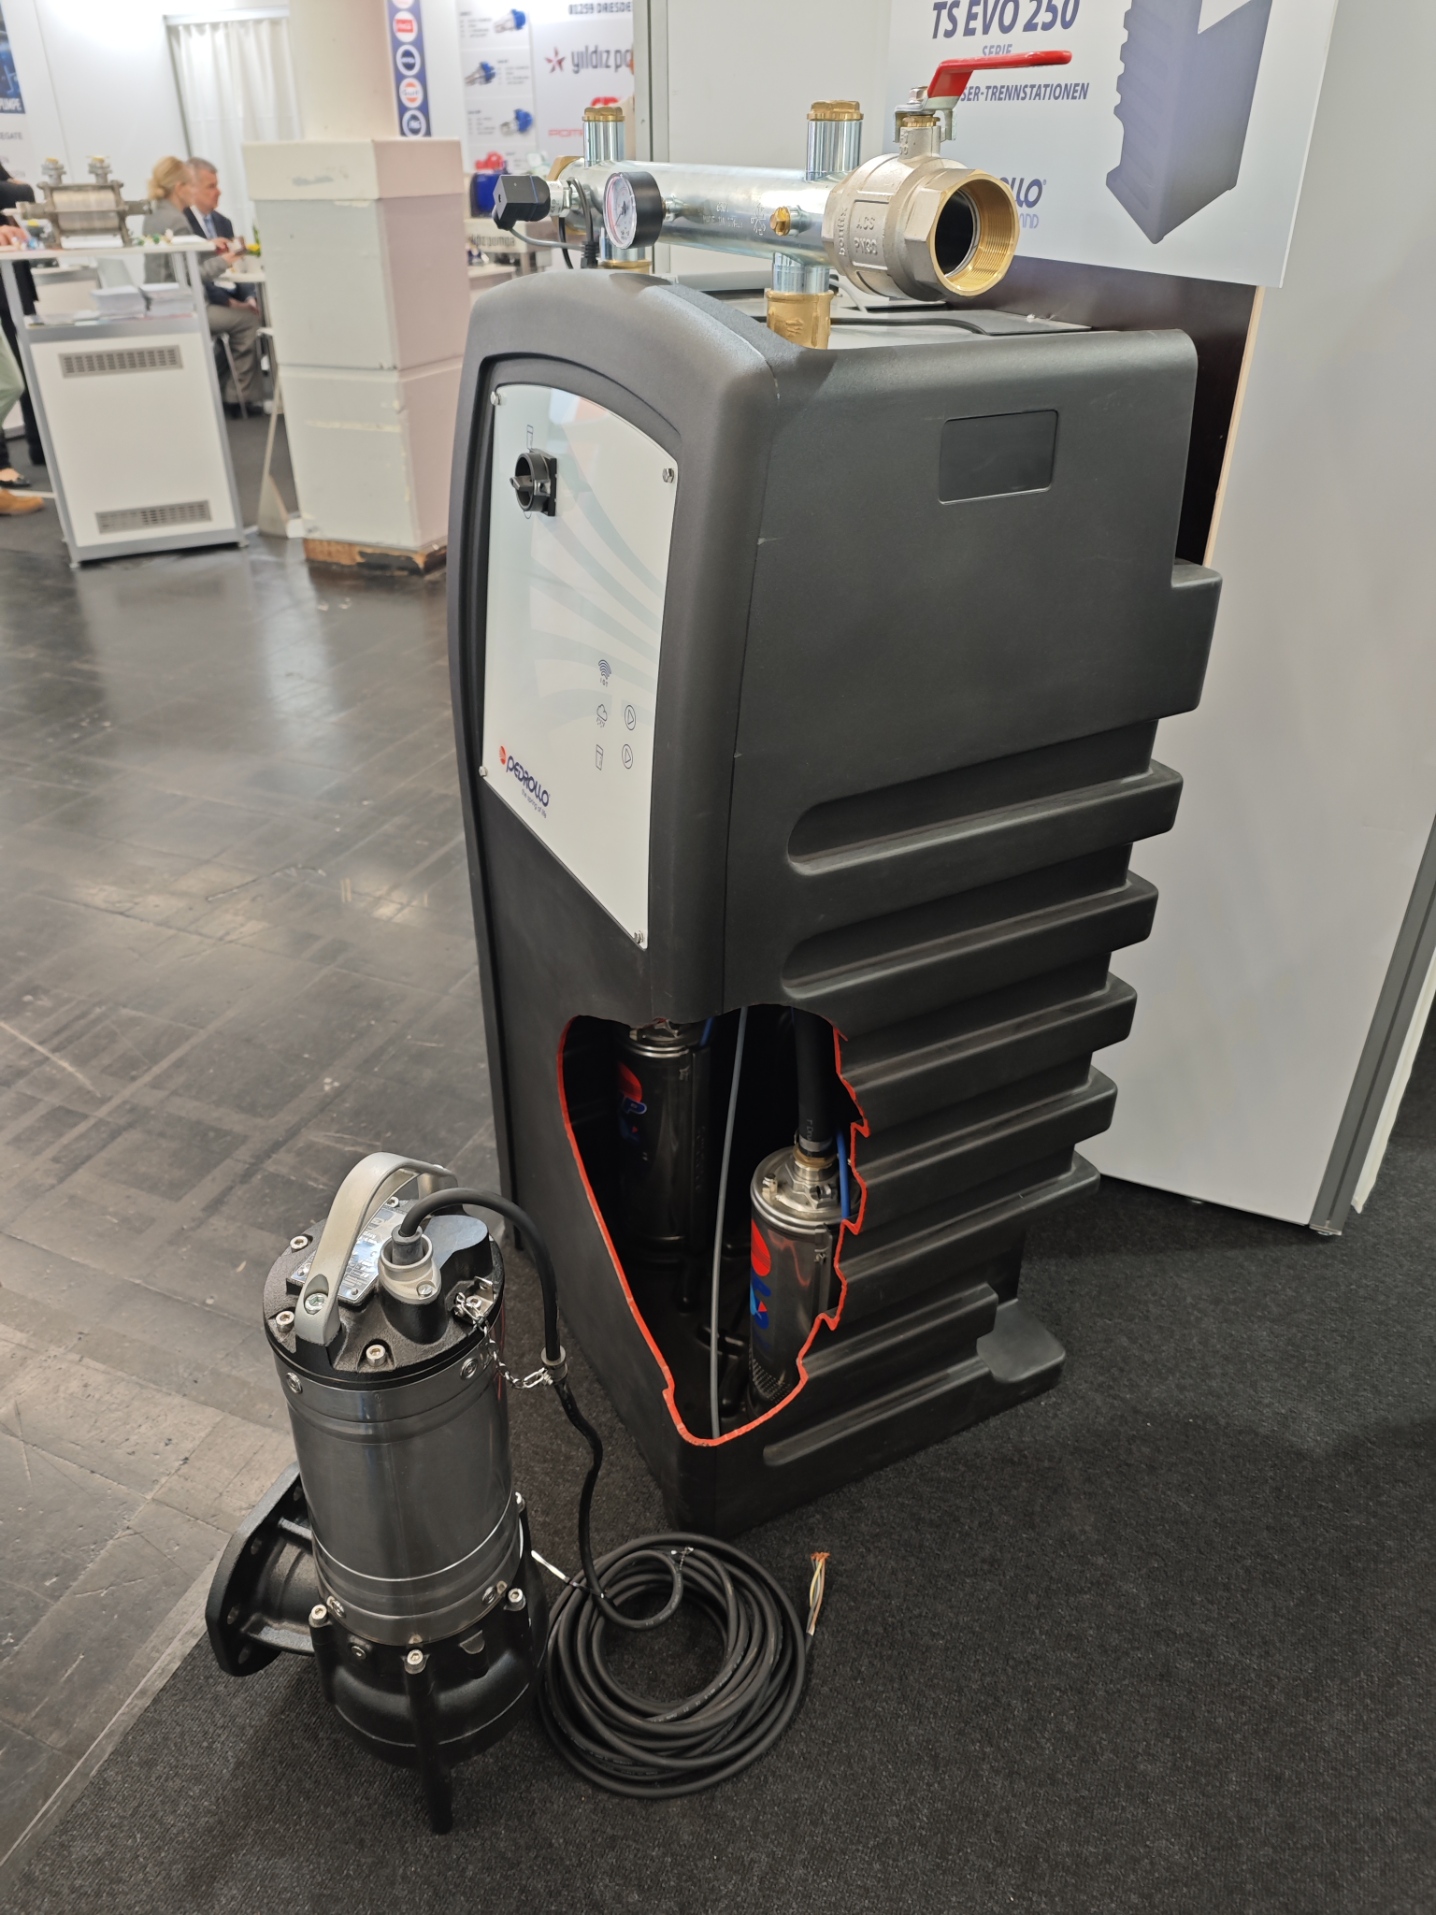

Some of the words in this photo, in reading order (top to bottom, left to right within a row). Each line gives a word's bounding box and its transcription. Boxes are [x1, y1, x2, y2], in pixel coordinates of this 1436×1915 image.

[932, 0, 960, 39] TS
[963, 0, 1020, 37] EVO
[1022, 0, 1080, 33] 250
[506, 755, 550, 808] PEDROLLO
